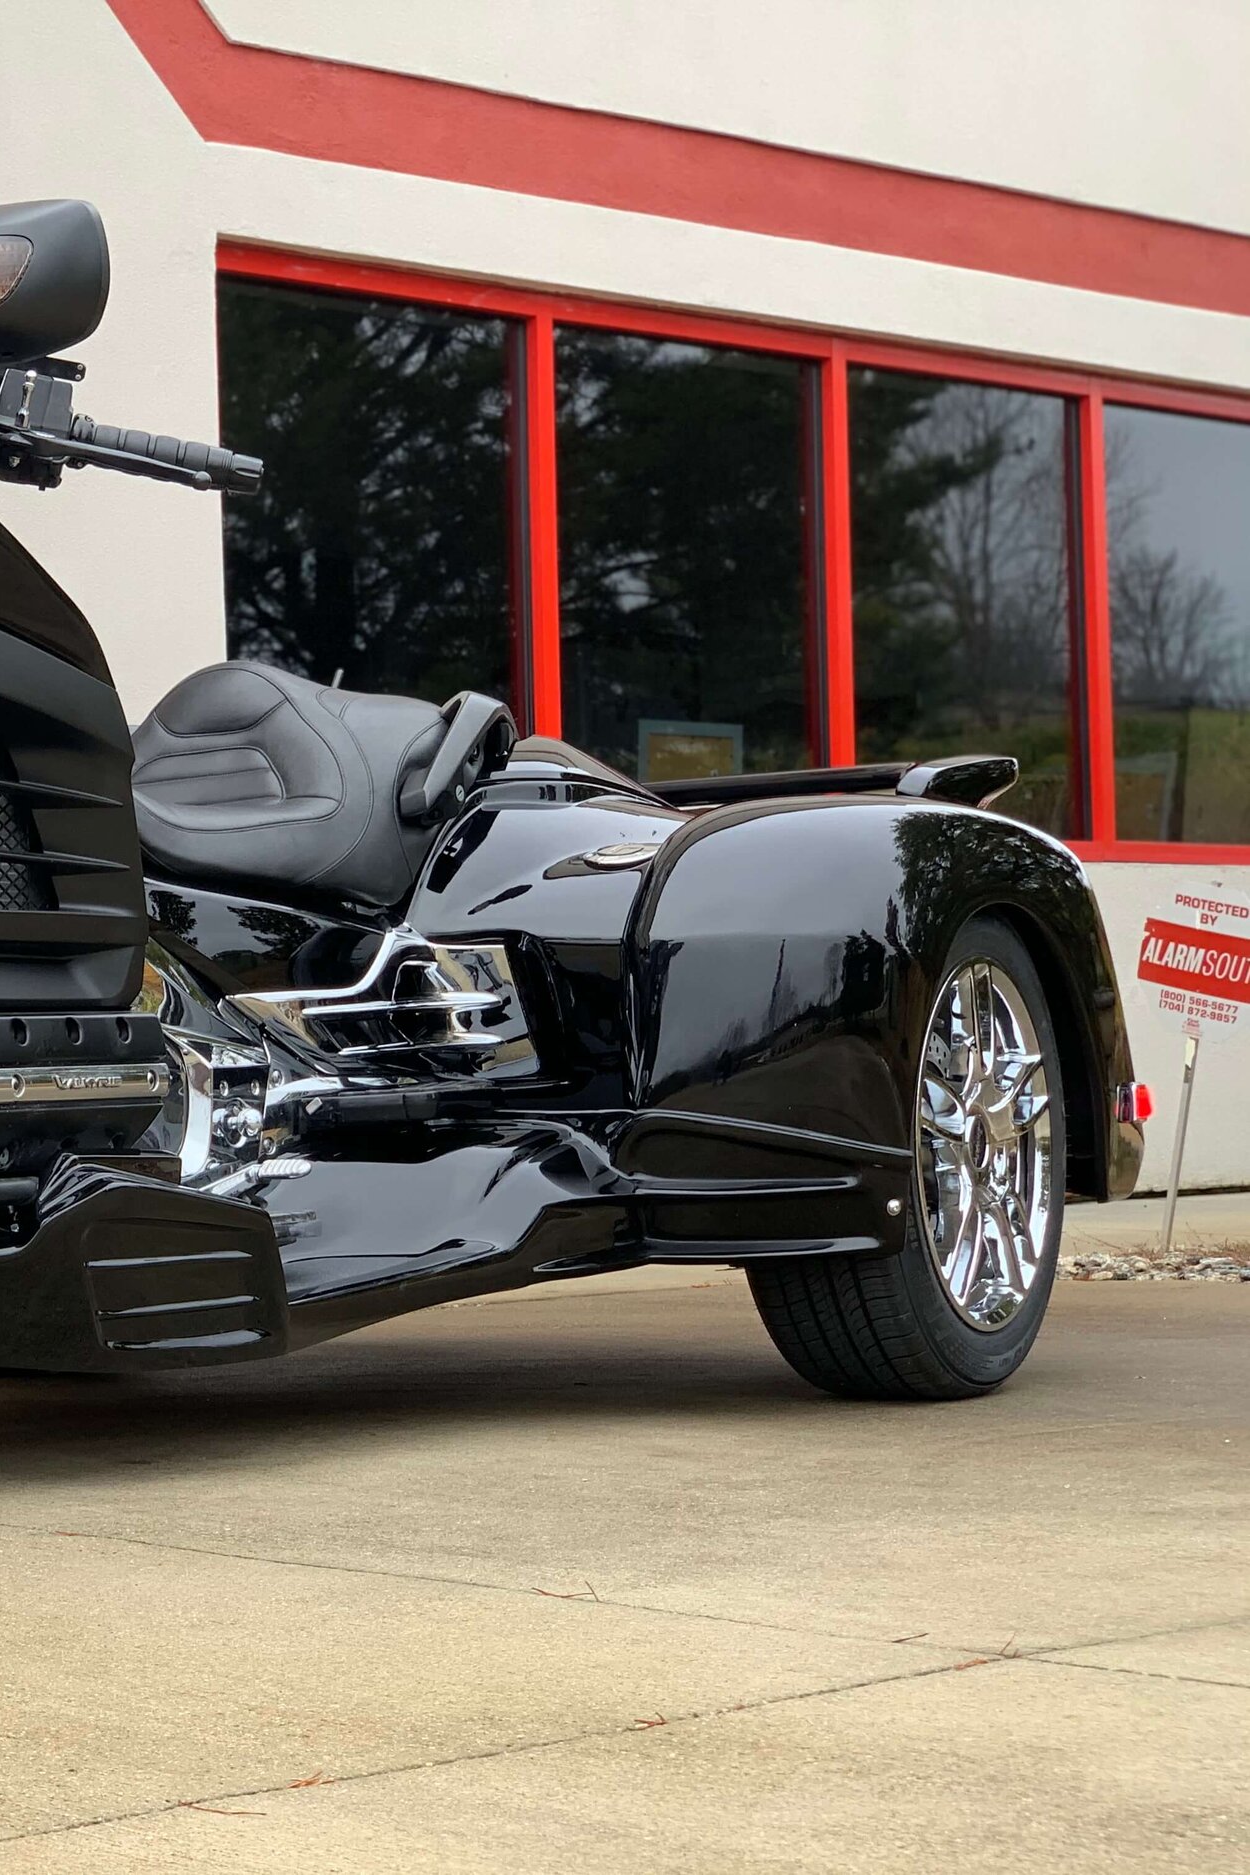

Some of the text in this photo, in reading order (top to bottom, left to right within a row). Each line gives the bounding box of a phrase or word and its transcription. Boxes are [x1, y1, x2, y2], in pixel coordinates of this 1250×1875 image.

[1175, 894, 1249, 919] PROTECTED
[1200, 914, 1218, 926] BY
[1159, 999, 1238, 1025] (704) 872-9857
[1160, 989, 1239, 1015] (800) 566-5677
